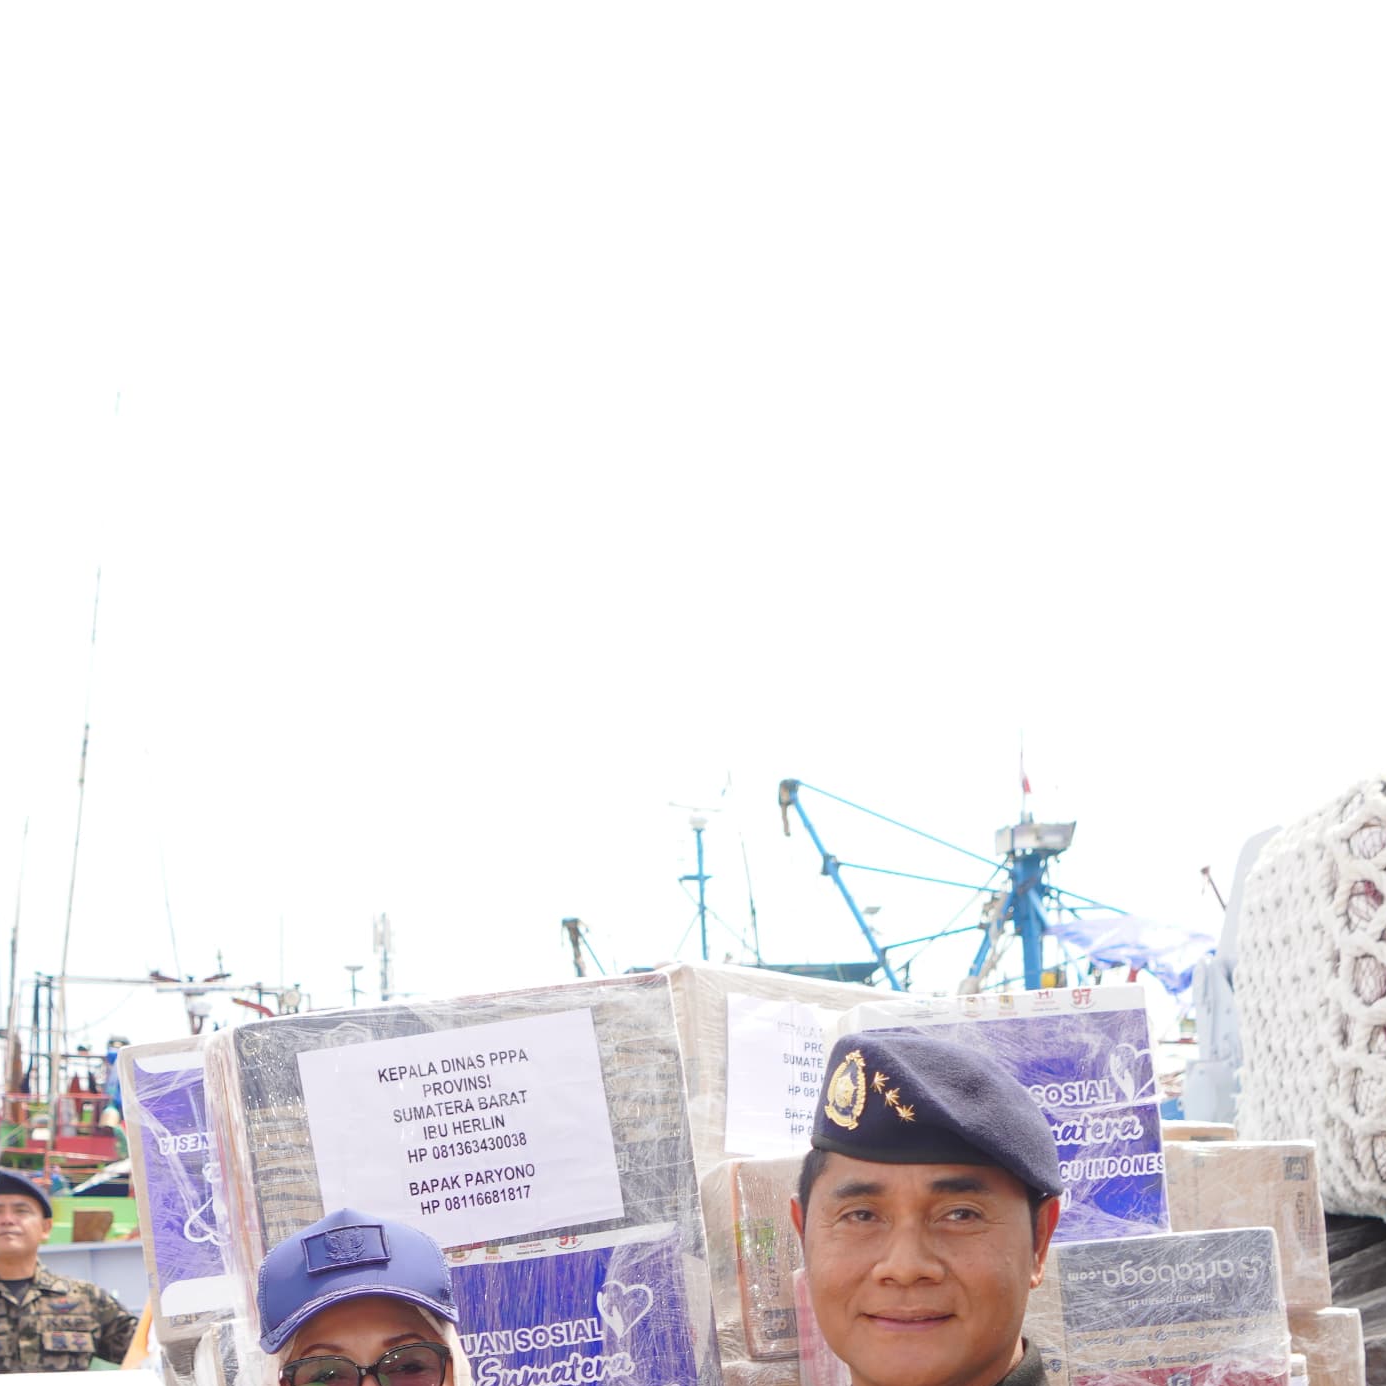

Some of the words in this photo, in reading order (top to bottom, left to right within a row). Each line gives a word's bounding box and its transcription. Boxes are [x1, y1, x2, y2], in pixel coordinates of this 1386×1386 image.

[377, 1062, 438, 1084] KEPALA
[441, 1054, 486, 1074] DINAS
[489, 1048, 529, 1067] PPPA
[800, 1073, 818, 1083] IBU
[422, 1075, 492, 1098] PROVINSI
[393, 1098, 475, 1123] SUMATERA
[478, 1089, 528, 1111] BARAT
[423, 1124, 448, 1140] IBU
[453, 1114, 506, 1136] HERLIN
[407, 1148, 428, 1164] HP
[432, 1132, 527, 1160] 081363430038
[409, 1175, 462, 1197] BAPAK
[464, 1163, 536, 1188] PARYONO
[420, 1199, 440, 1216] HP
[445, 1185, 531, 1212] 08116681817
[515, 1317, 604, 1352] SOSIAL
